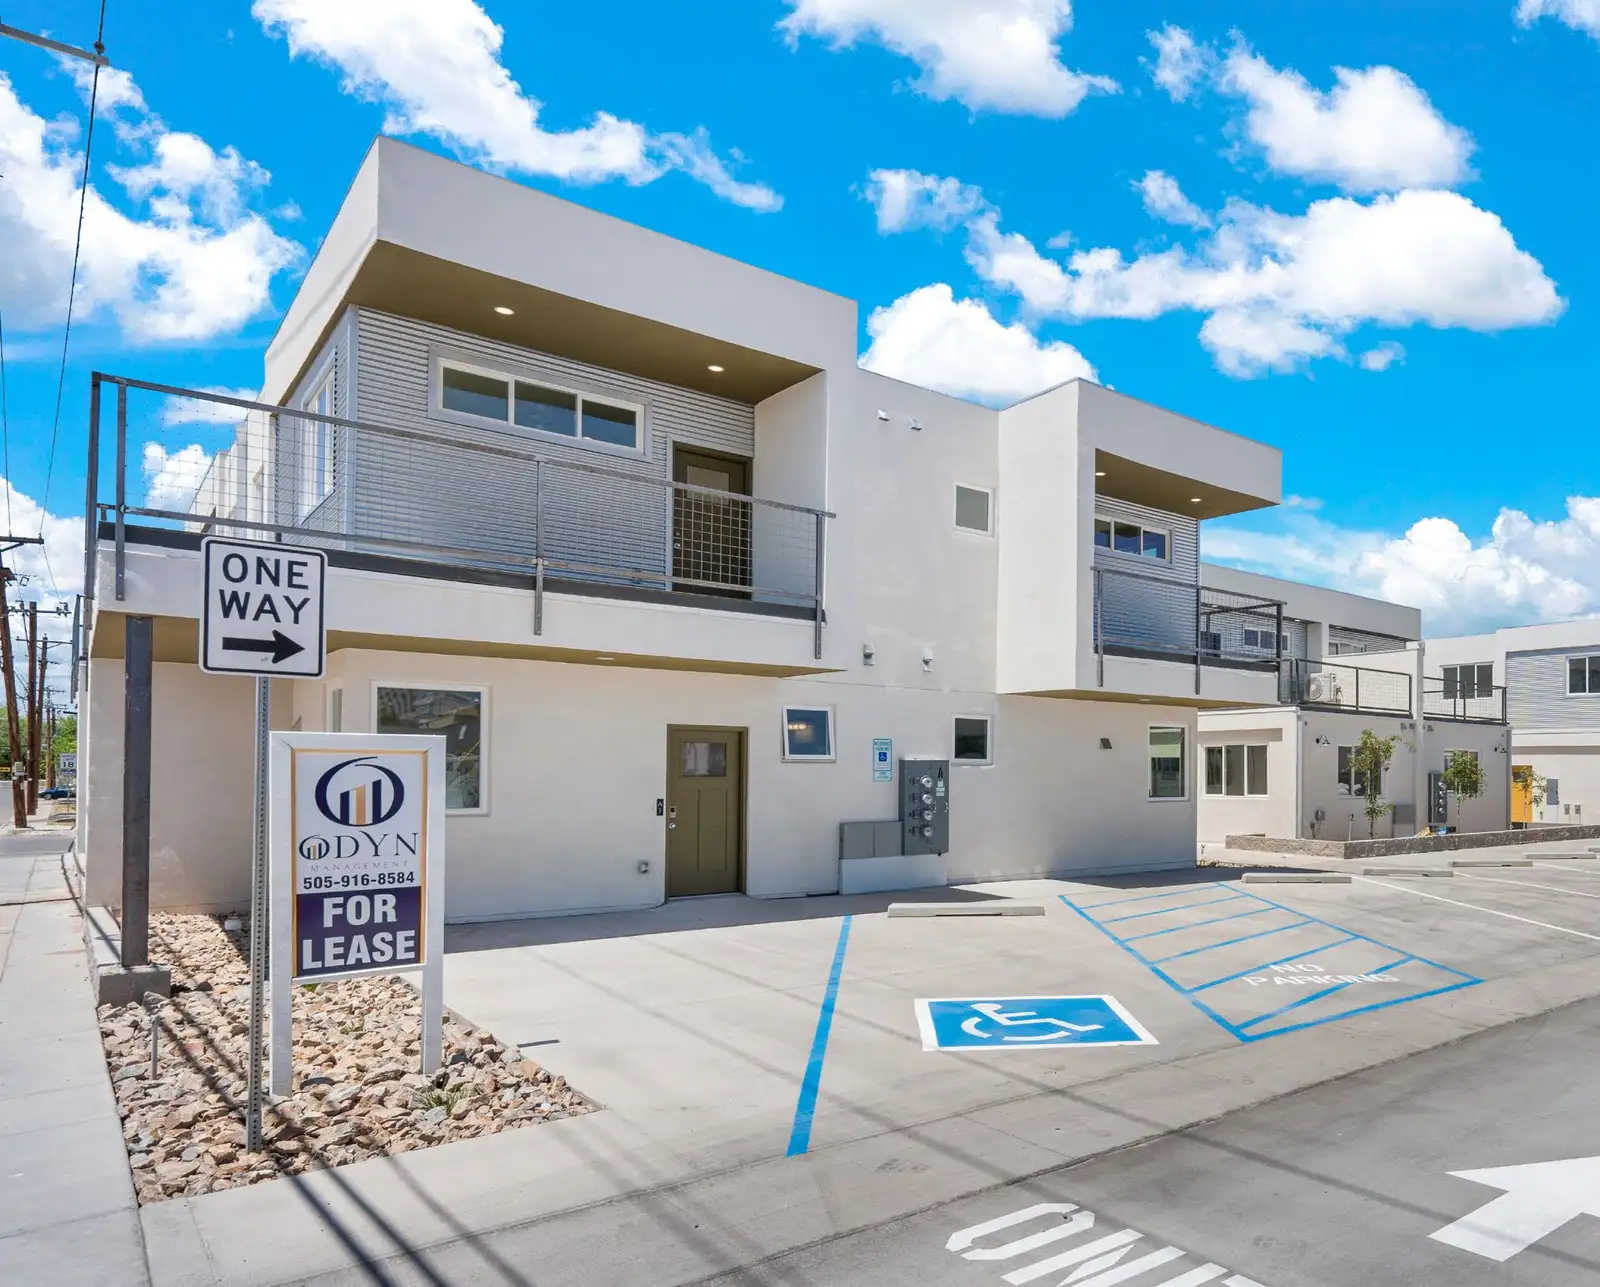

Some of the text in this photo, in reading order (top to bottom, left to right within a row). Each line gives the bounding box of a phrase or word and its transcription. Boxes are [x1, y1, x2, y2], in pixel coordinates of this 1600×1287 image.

[222, 553, 309, 590] ONE
[219, 588, 311, 625] WAY
[298, 830, 419, 860] ODYN
[303, 871, 415, 890] 505-916-8584
[310, 860, 409, 873] MANAGEMENT
[323, 893, 397, 928] FOR
[302, 930, 416, 970] LEASE
[1240, 973, 1400, 987] PARKING
[1268, 964, 1325, 973] NO
